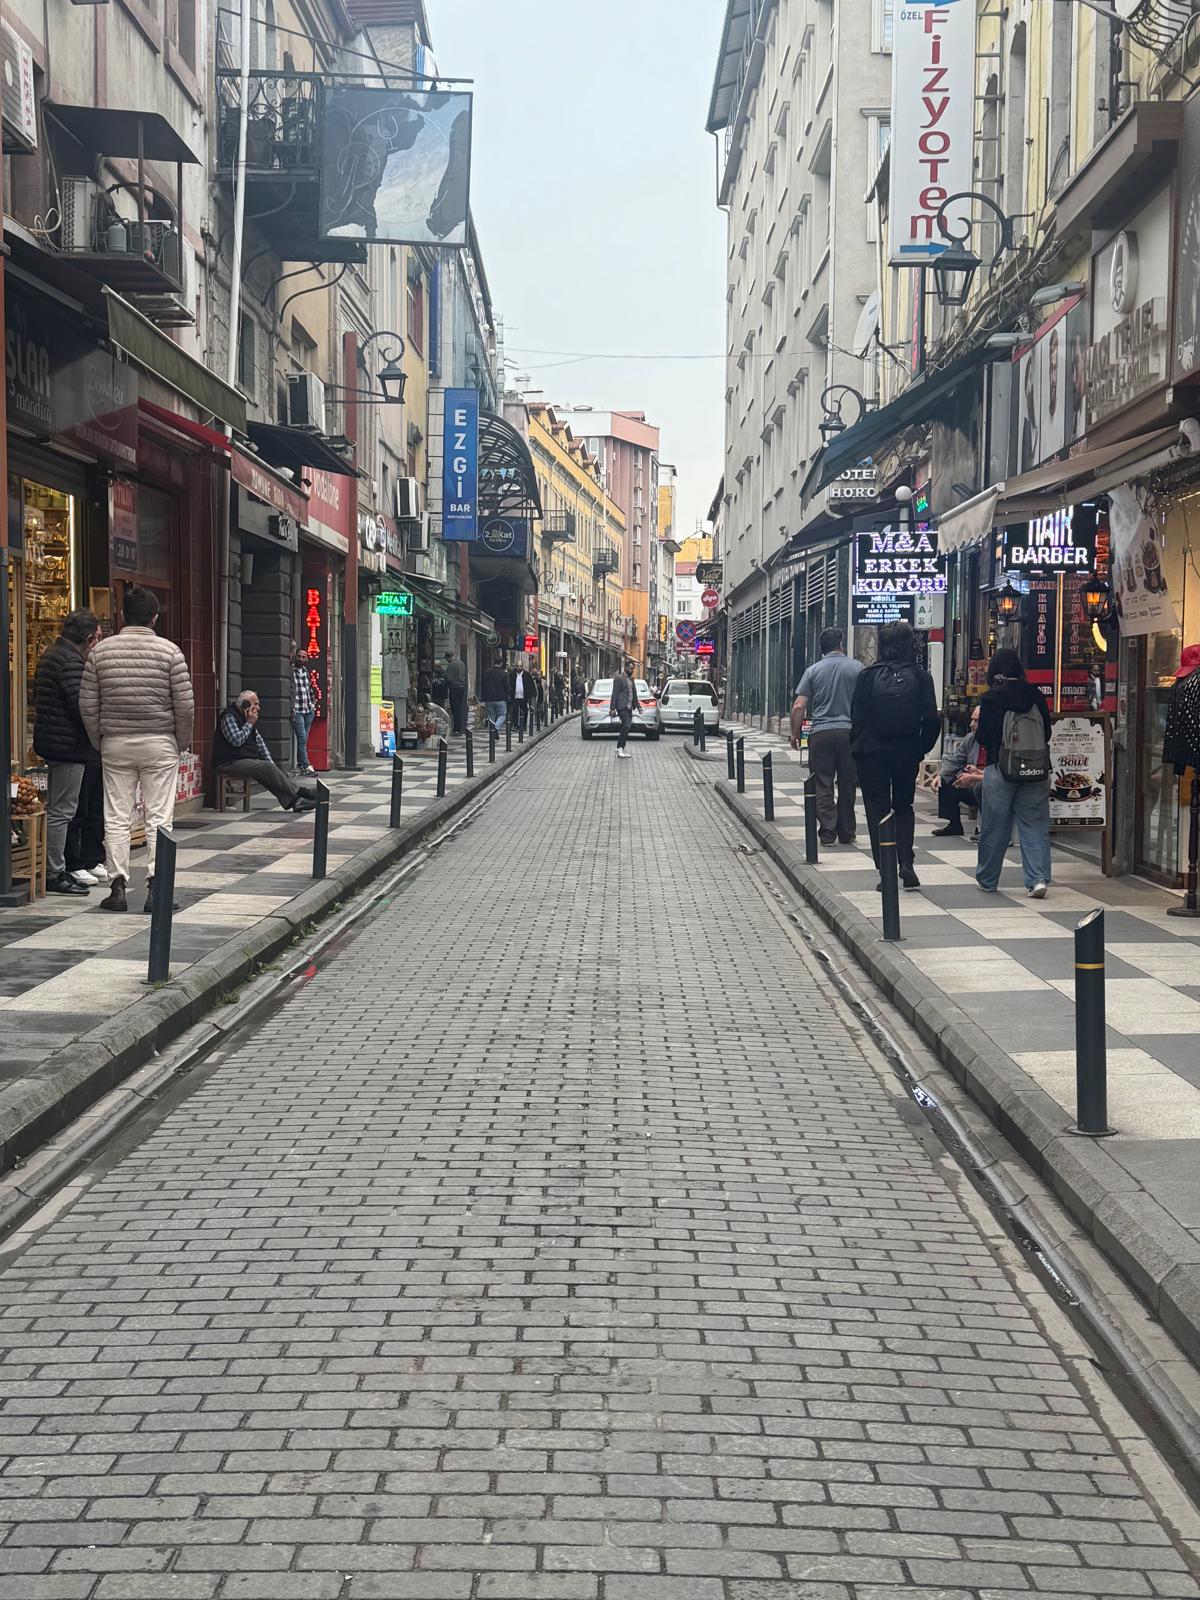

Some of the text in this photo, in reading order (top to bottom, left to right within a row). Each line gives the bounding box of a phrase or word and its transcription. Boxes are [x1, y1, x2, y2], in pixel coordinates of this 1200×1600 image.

[900, 9, 923, 20] ÖZEL
[450, 503, 471, 512] BAR
[498, 530, 513, 539] Kat
[869, 531, 934, 552] M&A
[1011, 546, 1089, 565] BARBER
[864, 558, 939, 573] ERKEK
[857, 574, 947, 591] KUAFÖRÜ
[1019, 768, 1045, 776] adidas
